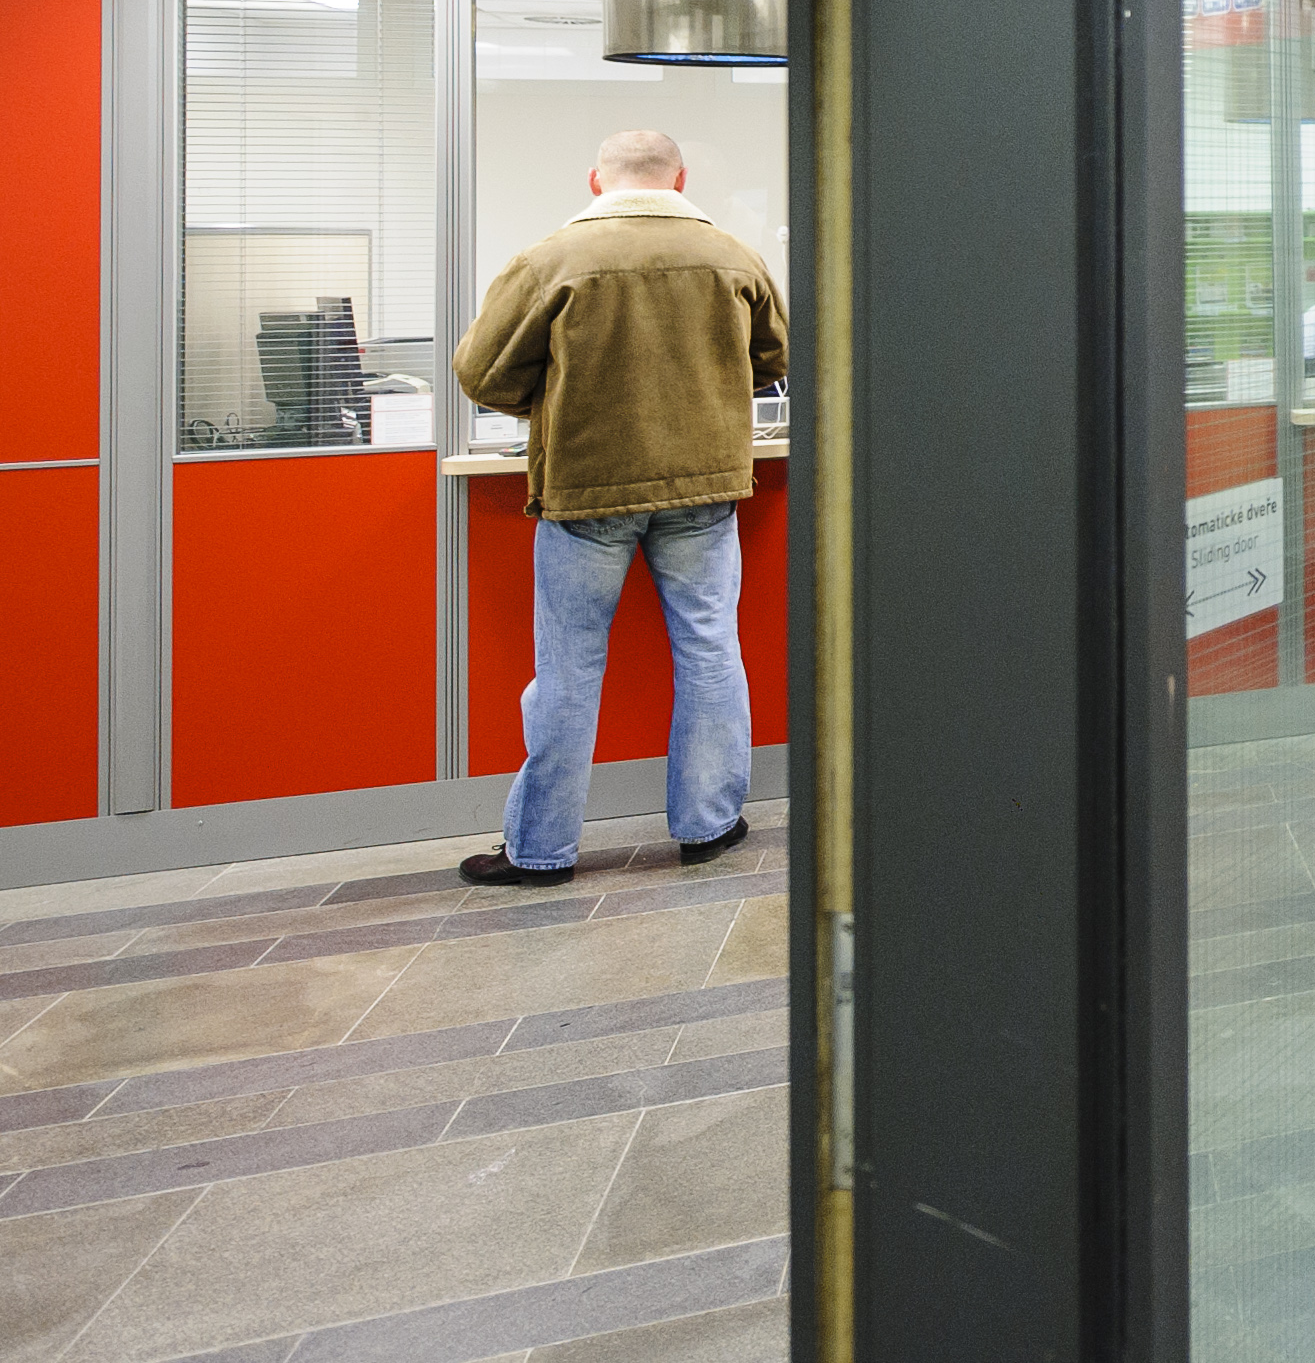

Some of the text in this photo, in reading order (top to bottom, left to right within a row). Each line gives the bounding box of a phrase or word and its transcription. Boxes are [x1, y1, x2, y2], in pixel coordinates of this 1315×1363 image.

[1247, 498, 1277, 519] dveře
[1191, 534, 1259, 569] Sliding door
